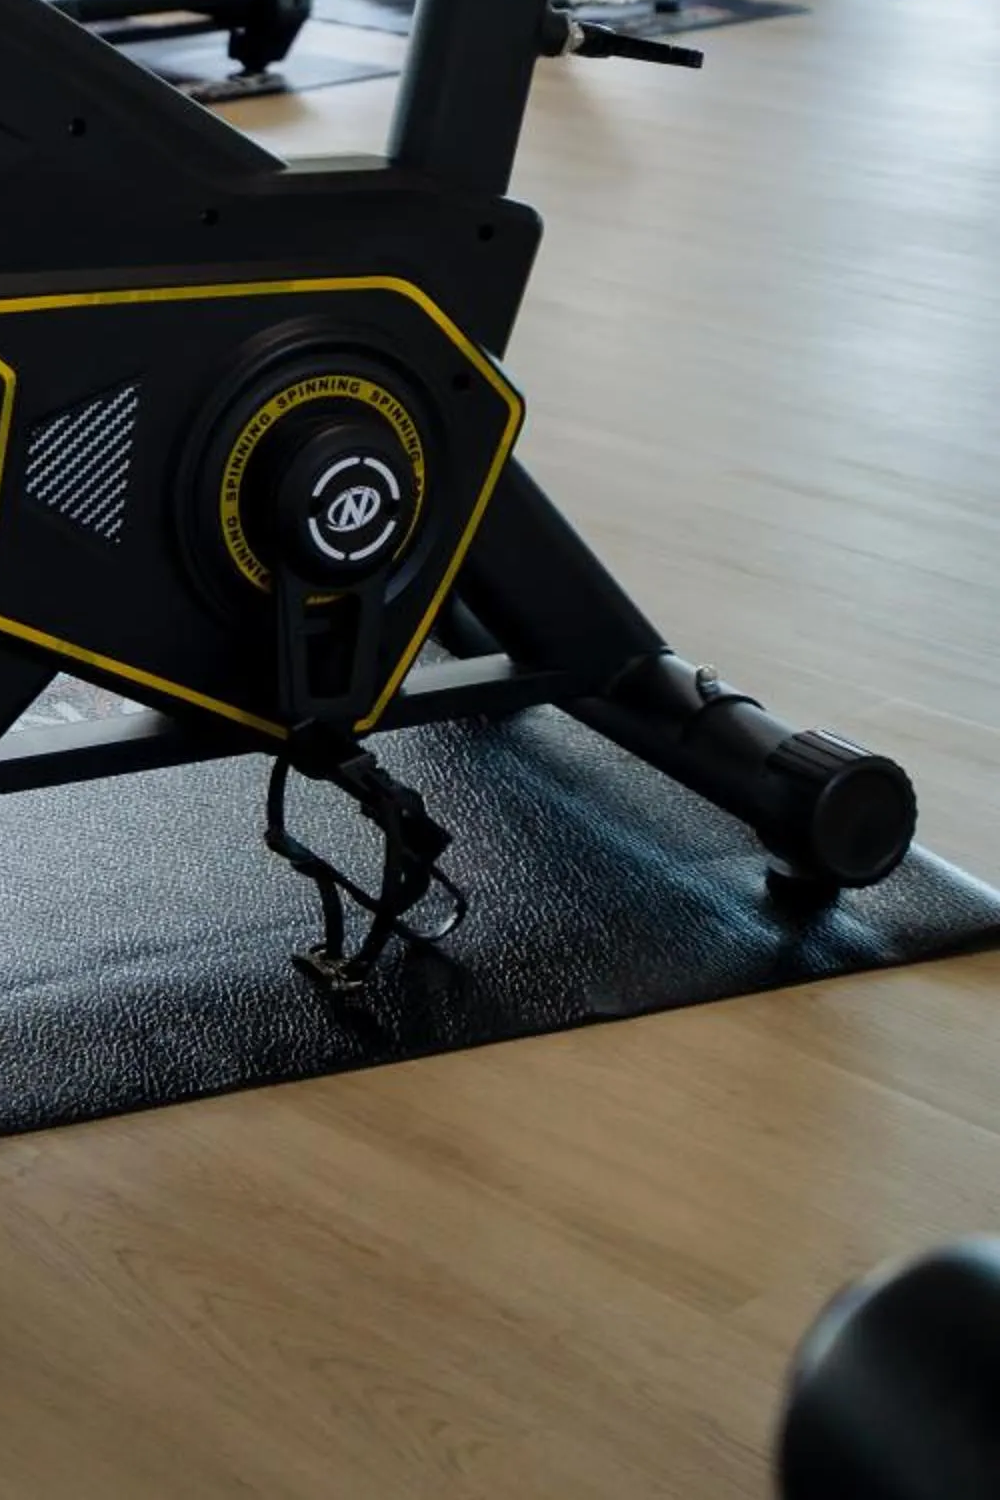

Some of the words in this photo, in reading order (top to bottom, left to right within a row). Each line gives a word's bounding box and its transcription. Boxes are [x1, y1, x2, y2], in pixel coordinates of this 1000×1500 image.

[226, 414, 272, 501] SPINNING
[276, 379, 361, 408] SPINNING
[371, 390, 421, 461] SPINNING
